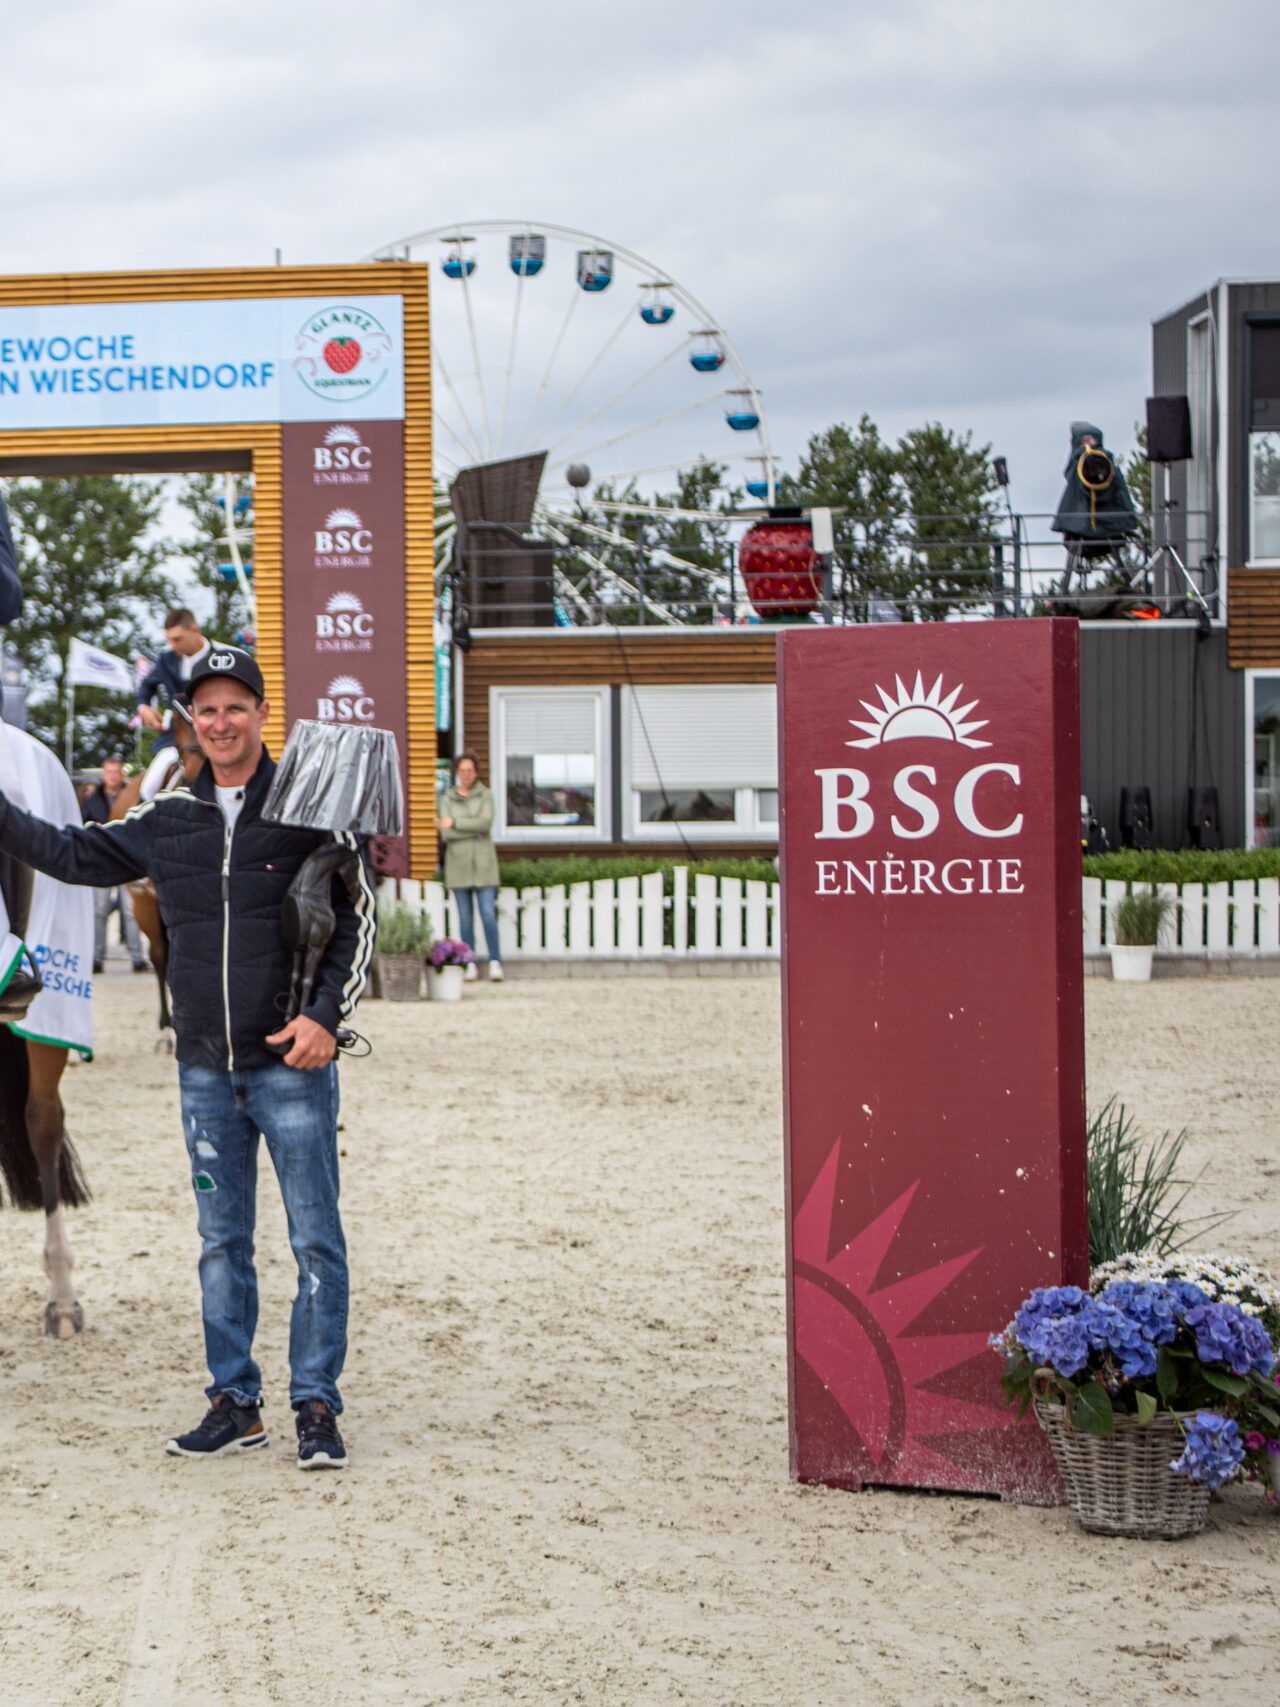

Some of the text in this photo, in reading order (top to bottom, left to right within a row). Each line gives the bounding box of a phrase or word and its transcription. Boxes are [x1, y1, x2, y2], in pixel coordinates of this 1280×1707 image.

[311, 312, 372, 334] GLANTZ
[31, 363, 275, 393] WIESCHENDORF
[314, 446, 372, 470] BSC
[315, 530, 373, 554] BSC
[316, 613, 374, 638] BSC
[317, 697, 375, 721] BSC
[814, 762, 1024, 840] BSC
[814, 858, 1024, 896] ENERGIE
